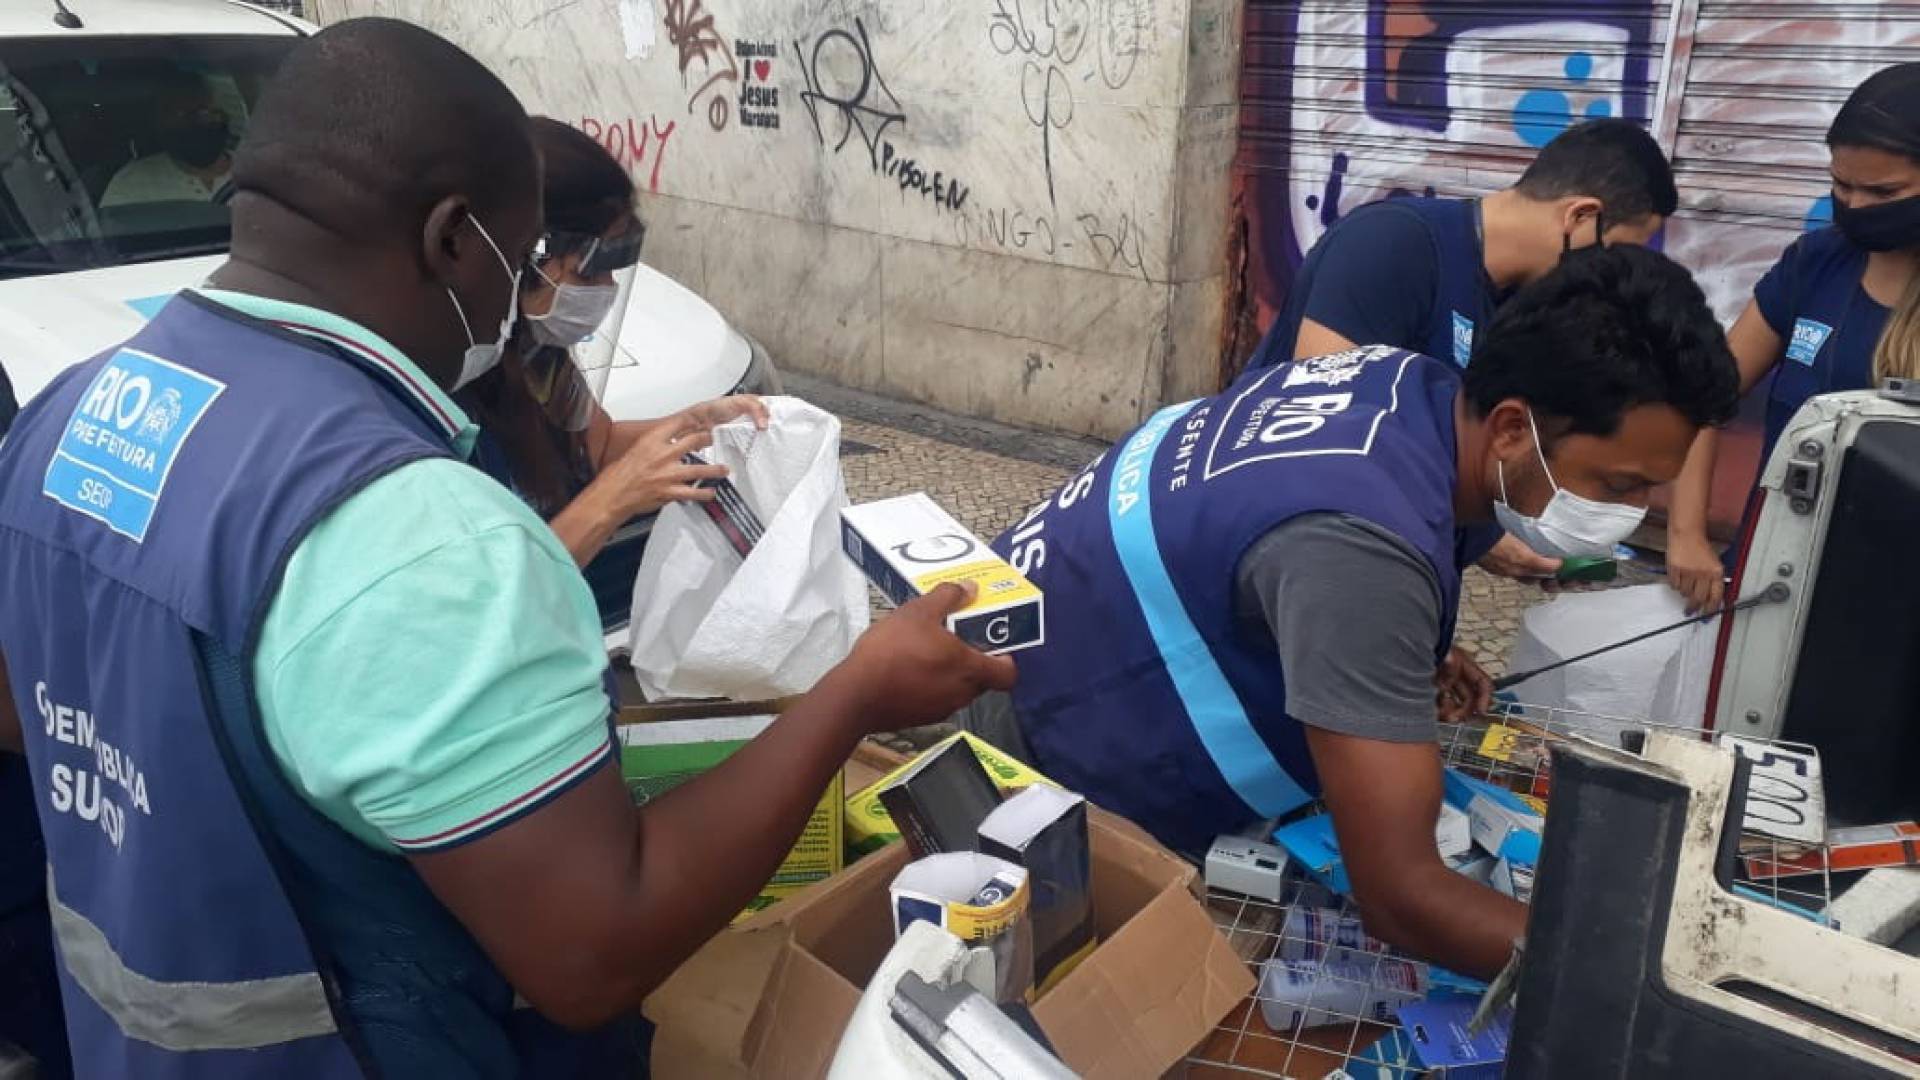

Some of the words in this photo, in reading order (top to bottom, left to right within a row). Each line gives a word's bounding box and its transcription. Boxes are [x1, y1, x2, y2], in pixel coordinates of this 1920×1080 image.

[739, 81, 779, 107] Jesus
[82, 366, 152, 430] RIO
[1260, 392, 1353, 443] RIO
[986, 615, 1009, 644] G
